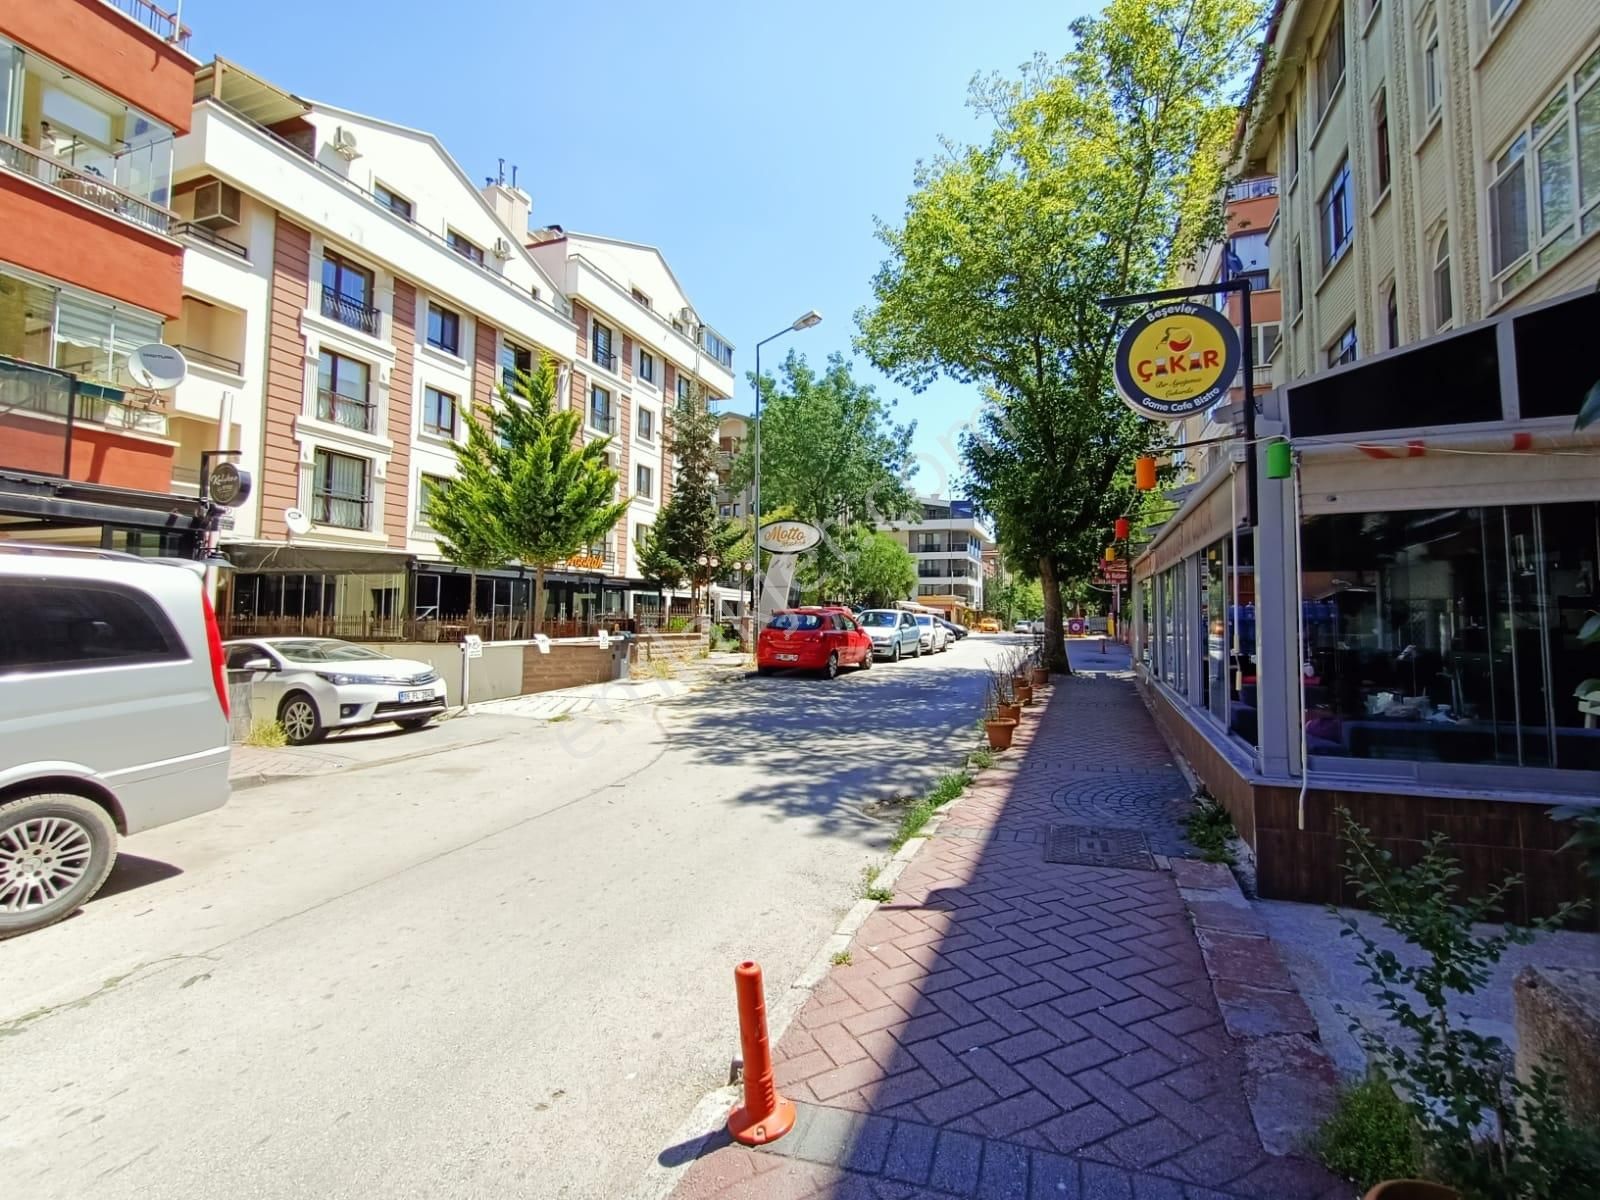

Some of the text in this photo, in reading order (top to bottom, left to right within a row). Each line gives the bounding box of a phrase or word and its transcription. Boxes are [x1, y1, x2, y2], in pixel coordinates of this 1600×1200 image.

[1146, 303, 1198, 322] Beşevler
[1142, 397, 1169, 412] Game
[1171, 402, 1193, 412] Cafe
[1194, 387, 1220, 407] Bistro
[764, 525, 806, 542] Motto
